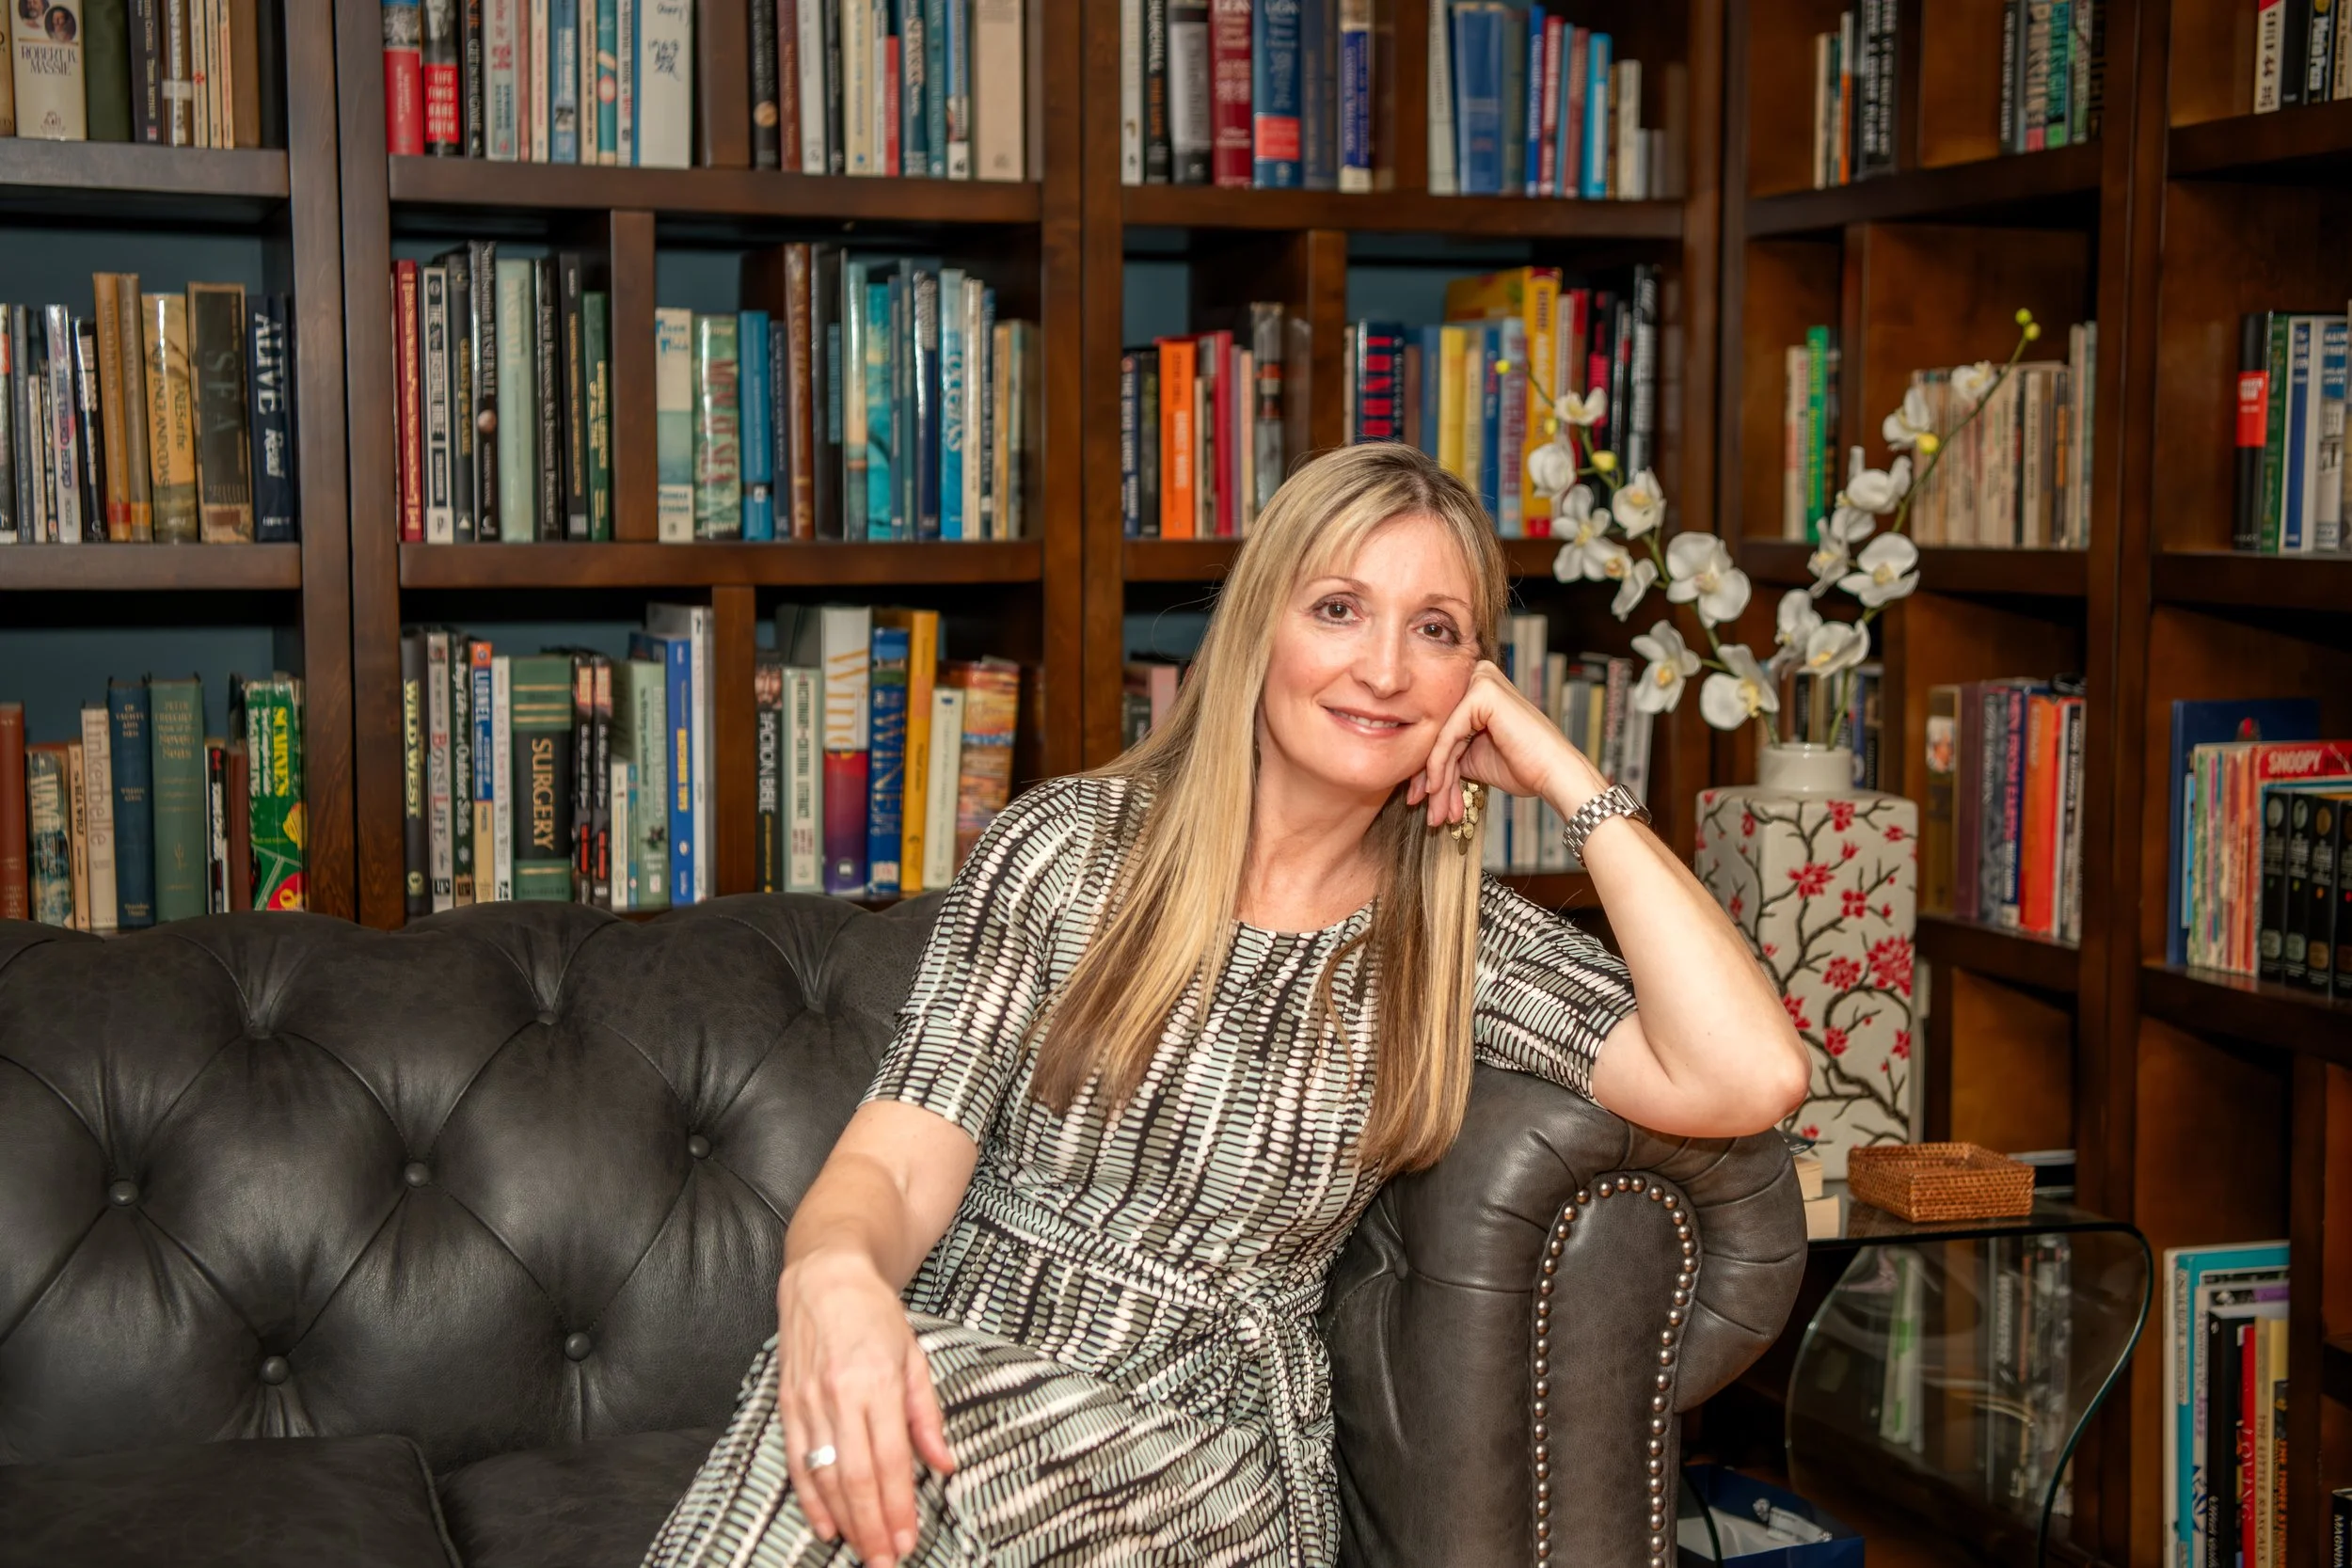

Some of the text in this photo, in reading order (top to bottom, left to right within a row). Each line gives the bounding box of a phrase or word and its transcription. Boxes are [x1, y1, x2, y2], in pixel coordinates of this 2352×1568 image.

[29, 59, 72, 76] MASSIE
[480, 243, 497, 399] Smithsonian BASEBALL
[503, 277, 519, 368] BASEBALL
[203, 349, 240, 432] SEA
[254, 312, 286, 416] ALIVE
[264, 426, 286, 480] Read
[700, 441, 739, 485] SEA
[474, 669, 491, 723] LIONEL
[825, 649, 869, 761] Wine
[85, 713, 112, 847] Tinkerbelle
[273, 705, 289, 798] SCARNE'S
[405, 680, 421, 818] WILD WEST
[455, 744, 472, 799] Outdoor
[758, 721, 775, 813] ACTION BIBLE
[2003, 691, 2021, 841] MEN FROM EARTH
[2267, 750, 2323, 776] SNOOPY
[74, 784, 84, 806] SEA
[75, 807, 85, 838] WOLF
[433, 795, 450, 842] LIFE
[456, 800, 472, 836] Skills
[531, 737, 555, 851] SURGERY
[654, 761, 668, 818] Soldiers
[677, 784, 689, 813] TOYS
[2257, 1413, 2269, 1563] THE LITTLE RASCALS
[2277, 1439, 2288, 1511] THE THREE
